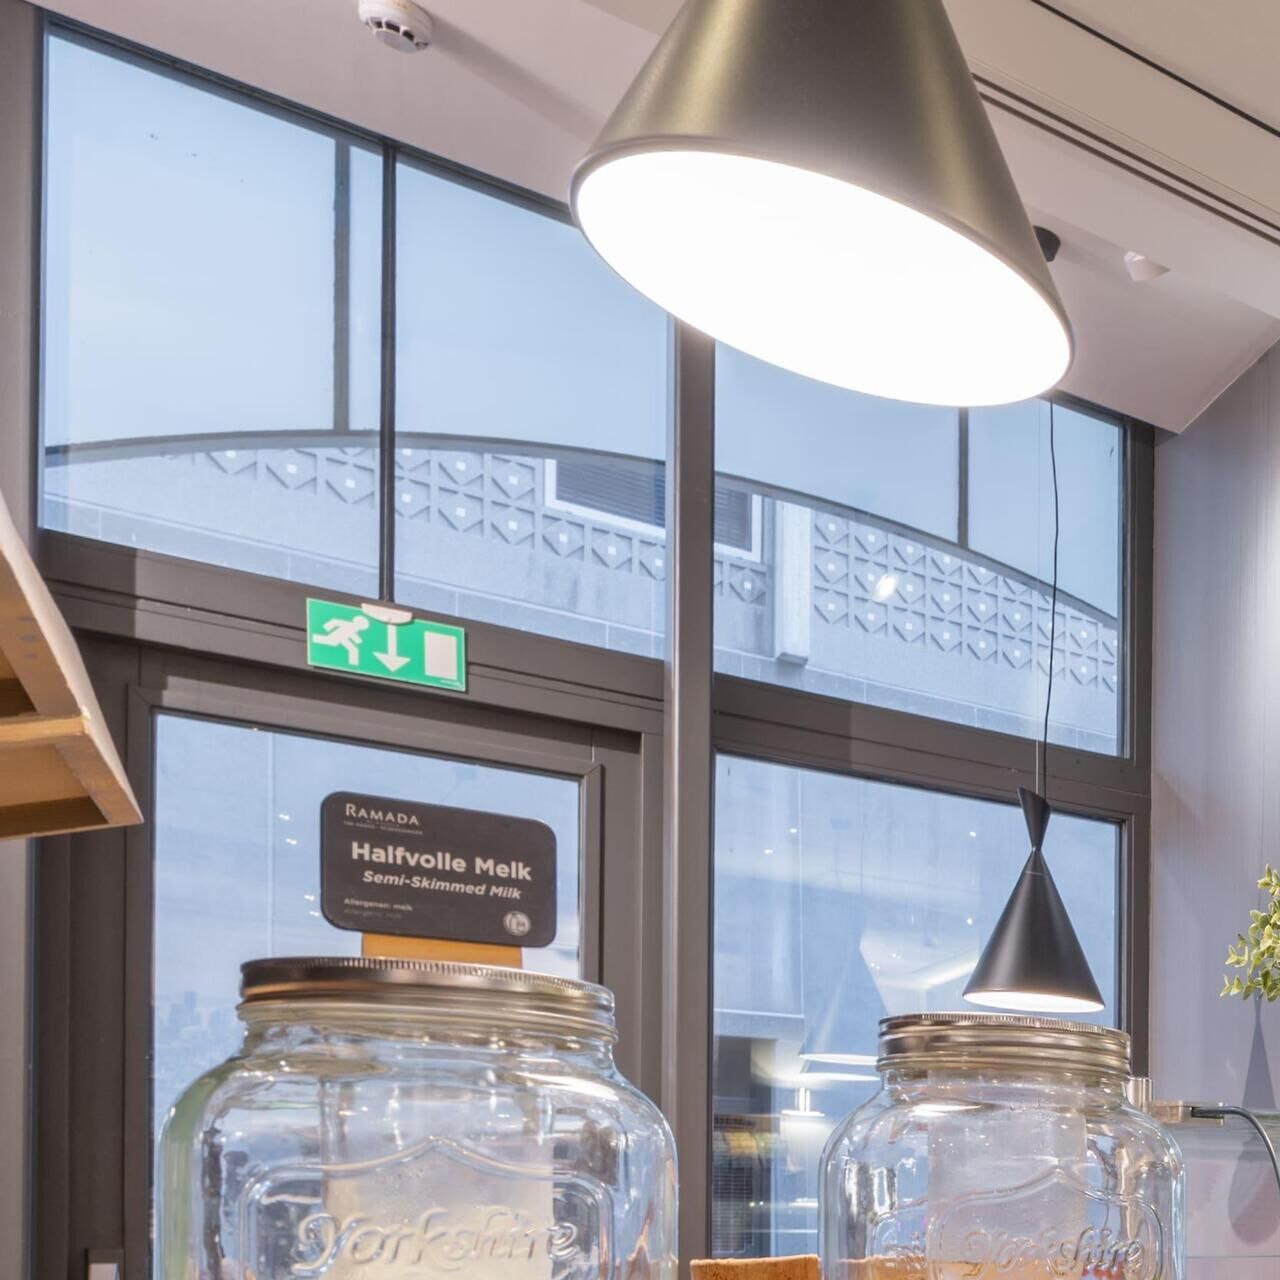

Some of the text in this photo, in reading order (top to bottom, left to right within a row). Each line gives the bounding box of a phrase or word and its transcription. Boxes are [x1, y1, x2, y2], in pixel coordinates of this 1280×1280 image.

[345, 803, 419, 826] RAMADA
[352, 841, 532, 881] Halfvolle Melk
[363, 870, 522, 900] Semi-Skimmed Milk
[291, 1205, 579, 1275] Yorkshire
